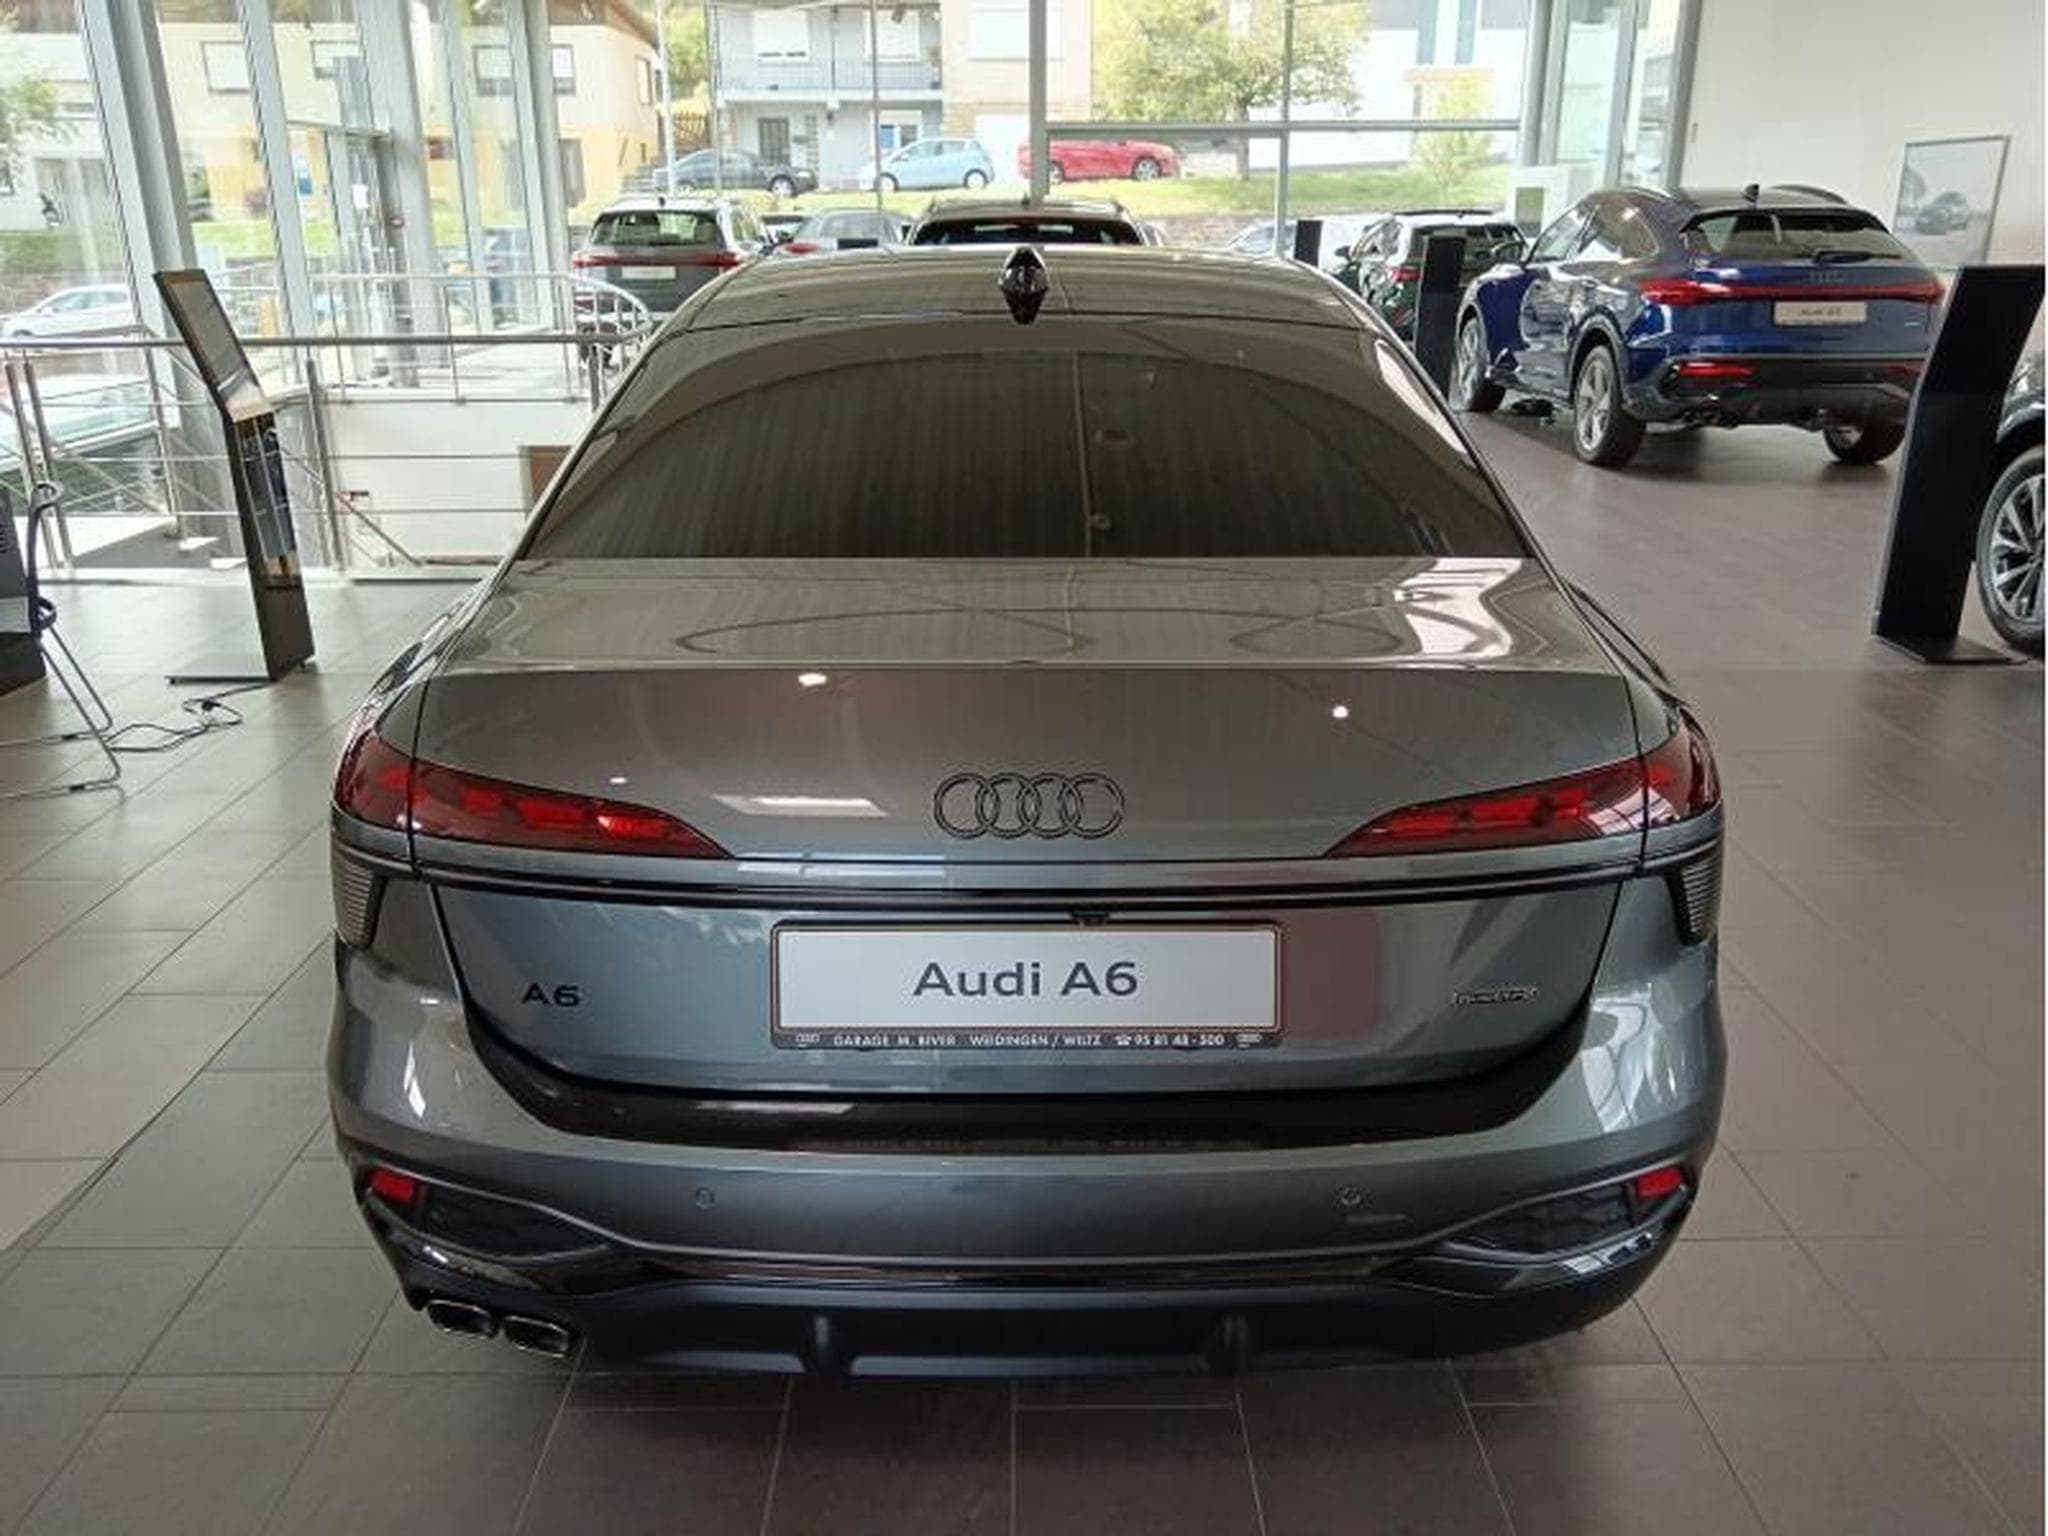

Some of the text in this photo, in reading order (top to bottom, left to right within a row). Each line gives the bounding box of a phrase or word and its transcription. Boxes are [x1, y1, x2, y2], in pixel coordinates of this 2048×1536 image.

[913, 961, 1138, 996] Audi A6
[521, 982, 579, 1007] A6
[833, 1034, 888, 1047] GARAGE
